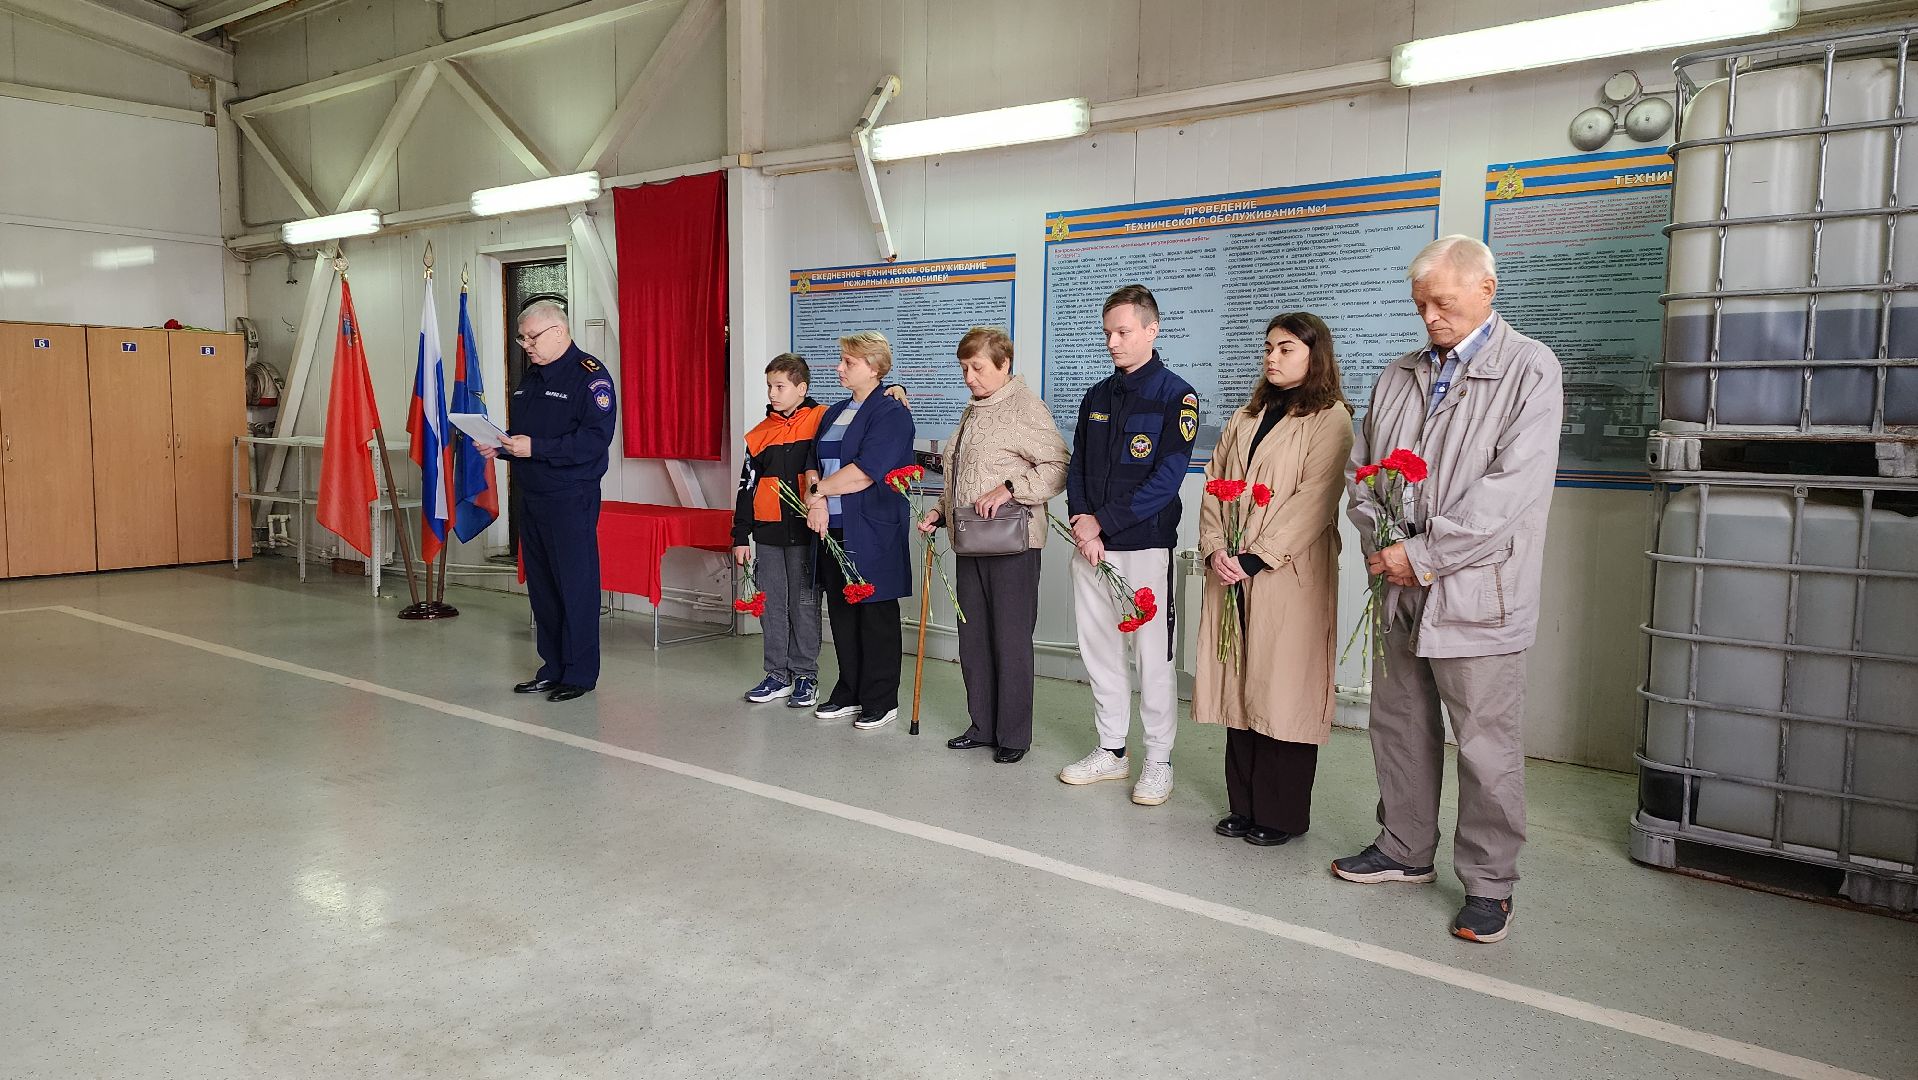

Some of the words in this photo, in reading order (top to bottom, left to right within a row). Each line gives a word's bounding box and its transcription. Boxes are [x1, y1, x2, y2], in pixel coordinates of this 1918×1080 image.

[1183, 200, 1257, 215] ПРОВЕДЕНИЕ
[1124, 214, 1206, 231] ТЕХНИЧЕСКОГО
[1209, 206, 1303, 224] ОБСЛУЖИВАНИЯ
[1307, 203, 1328, 214] №1
[812, 270, 860, 281] ЕЖЕДНЕВНОЕ
[864, 266, 917, 277] ТЕХНИЧЕСКОЕ
[920, 261, 987, 273] ОБСЛУЖИВАНИЕ
[844, 278, 888, 287] ПОЖАРНЫХ
[888, 273, 948, 284] АВТОМОБИЛЕЙ
[38, 339, 45, 347] 6
[126, 343, 132, 351] 7
[205, 347, 211, 355] 8
